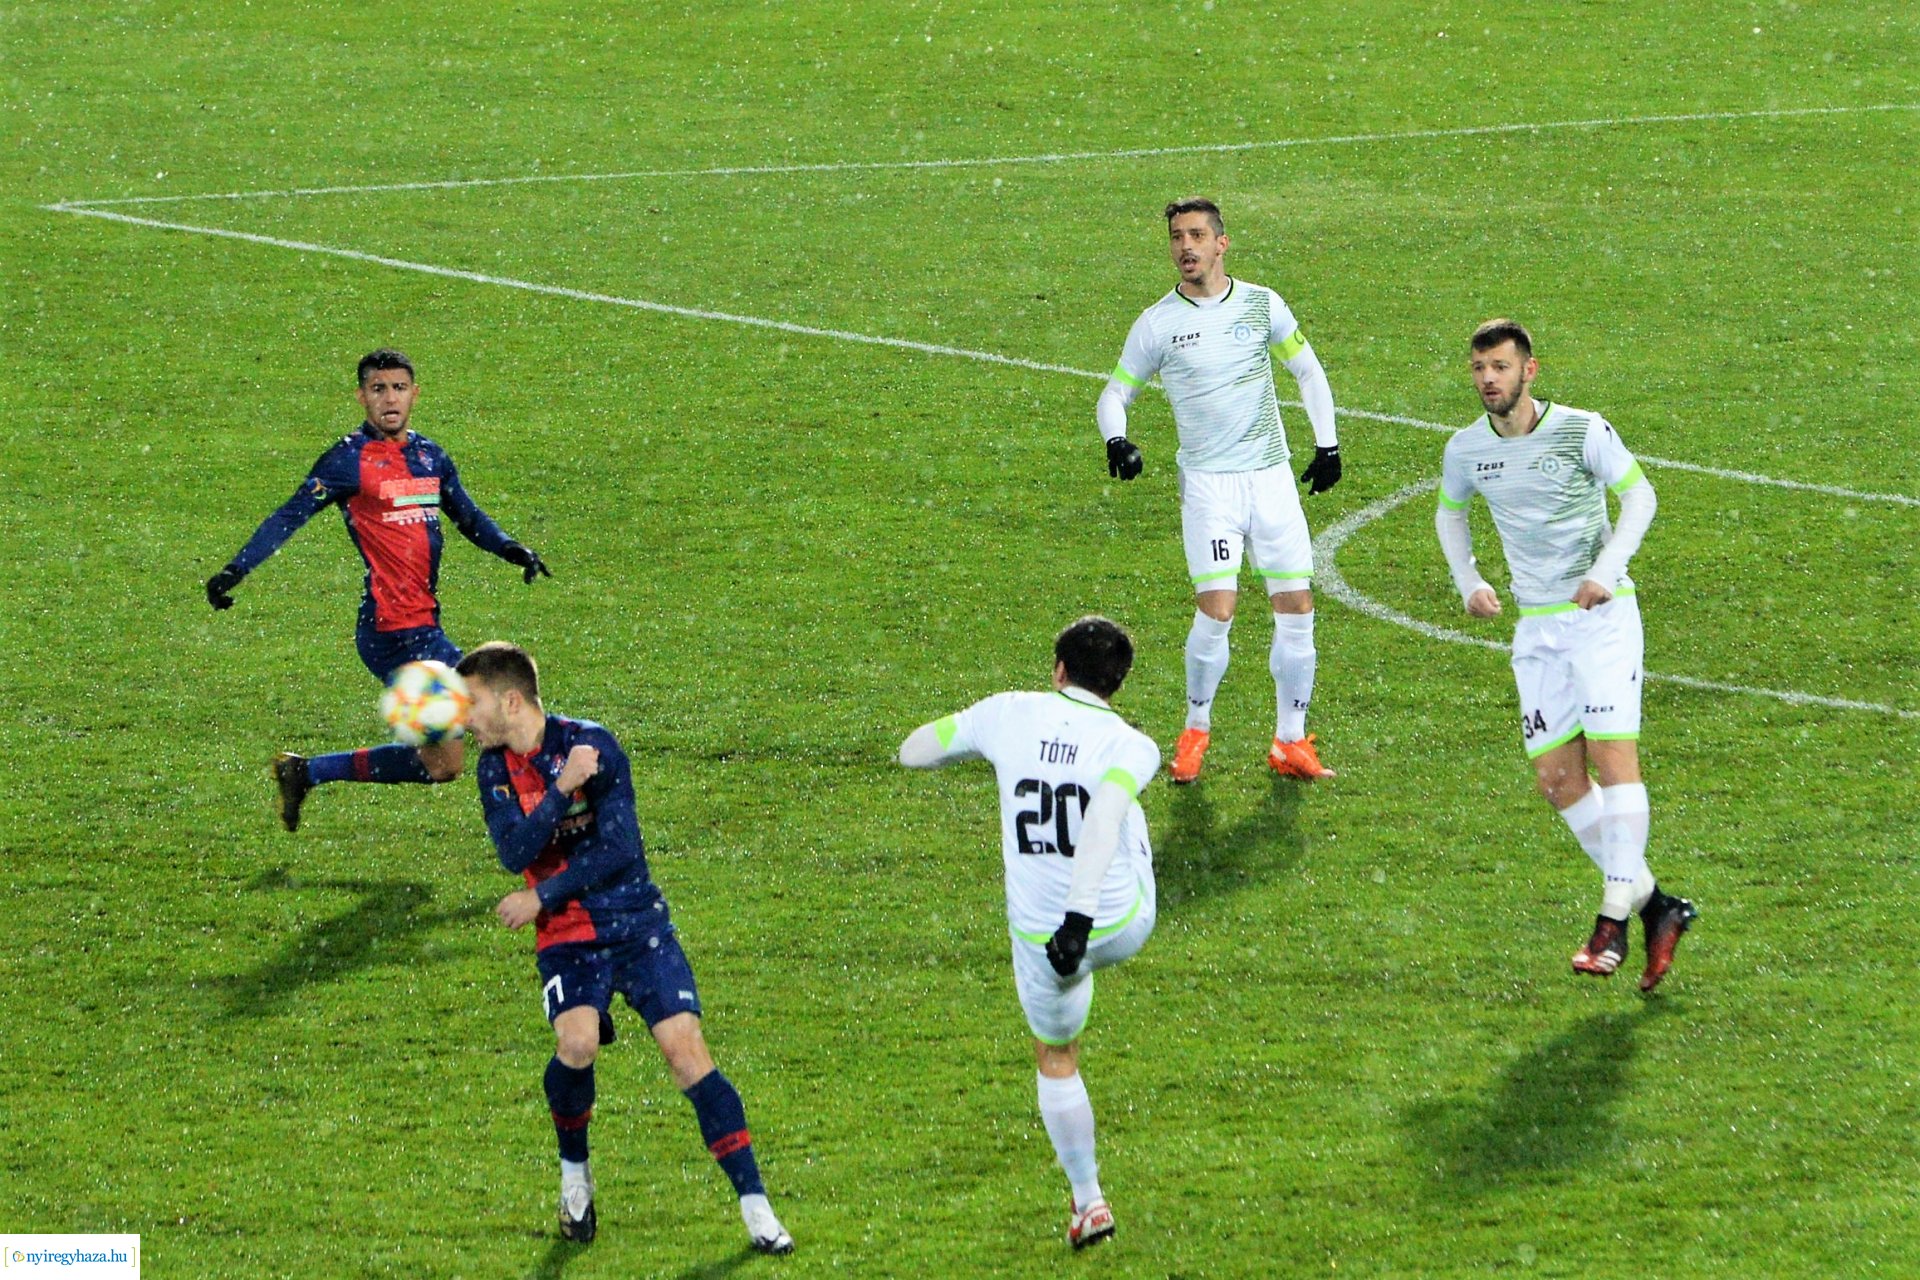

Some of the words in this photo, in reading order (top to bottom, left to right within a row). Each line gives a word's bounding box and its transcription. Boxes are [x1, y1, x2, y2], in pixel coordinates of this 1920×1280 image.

[1211, 538, 1230, 562] 16
[1522, 708, 1548, 740] 34
[1039, 736, 1079, 766] TÓTH
[1014, 777, 1091, 858] 20
